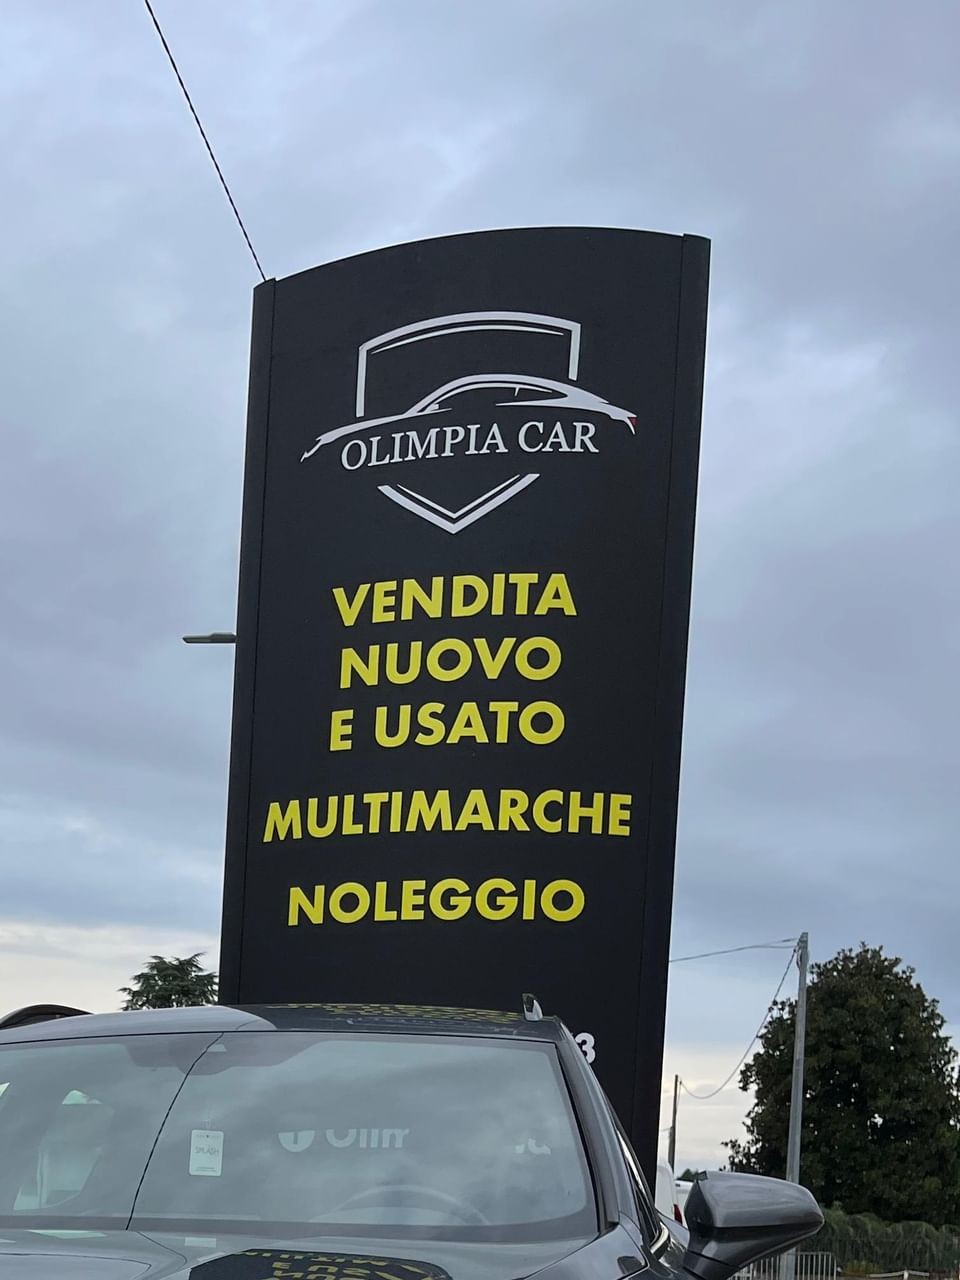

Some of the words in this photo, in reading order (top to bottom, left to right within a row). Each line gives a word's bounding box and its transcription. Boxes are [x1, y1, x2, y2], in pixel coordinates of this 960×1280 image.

[341, 422, 508, 470] OLIMPIA
[518, 422, 599, 453] CAR
[333, 573, 577, 626] VENDITA
[340, 636, 562, 689] NUOVO
[329, 709, 353, 751] E
[374, 701, 565, 748] USATO
[263, 789, 632, 842] MULTIMARCHE
[288, 878, 585, 926] NOLEGGIO
